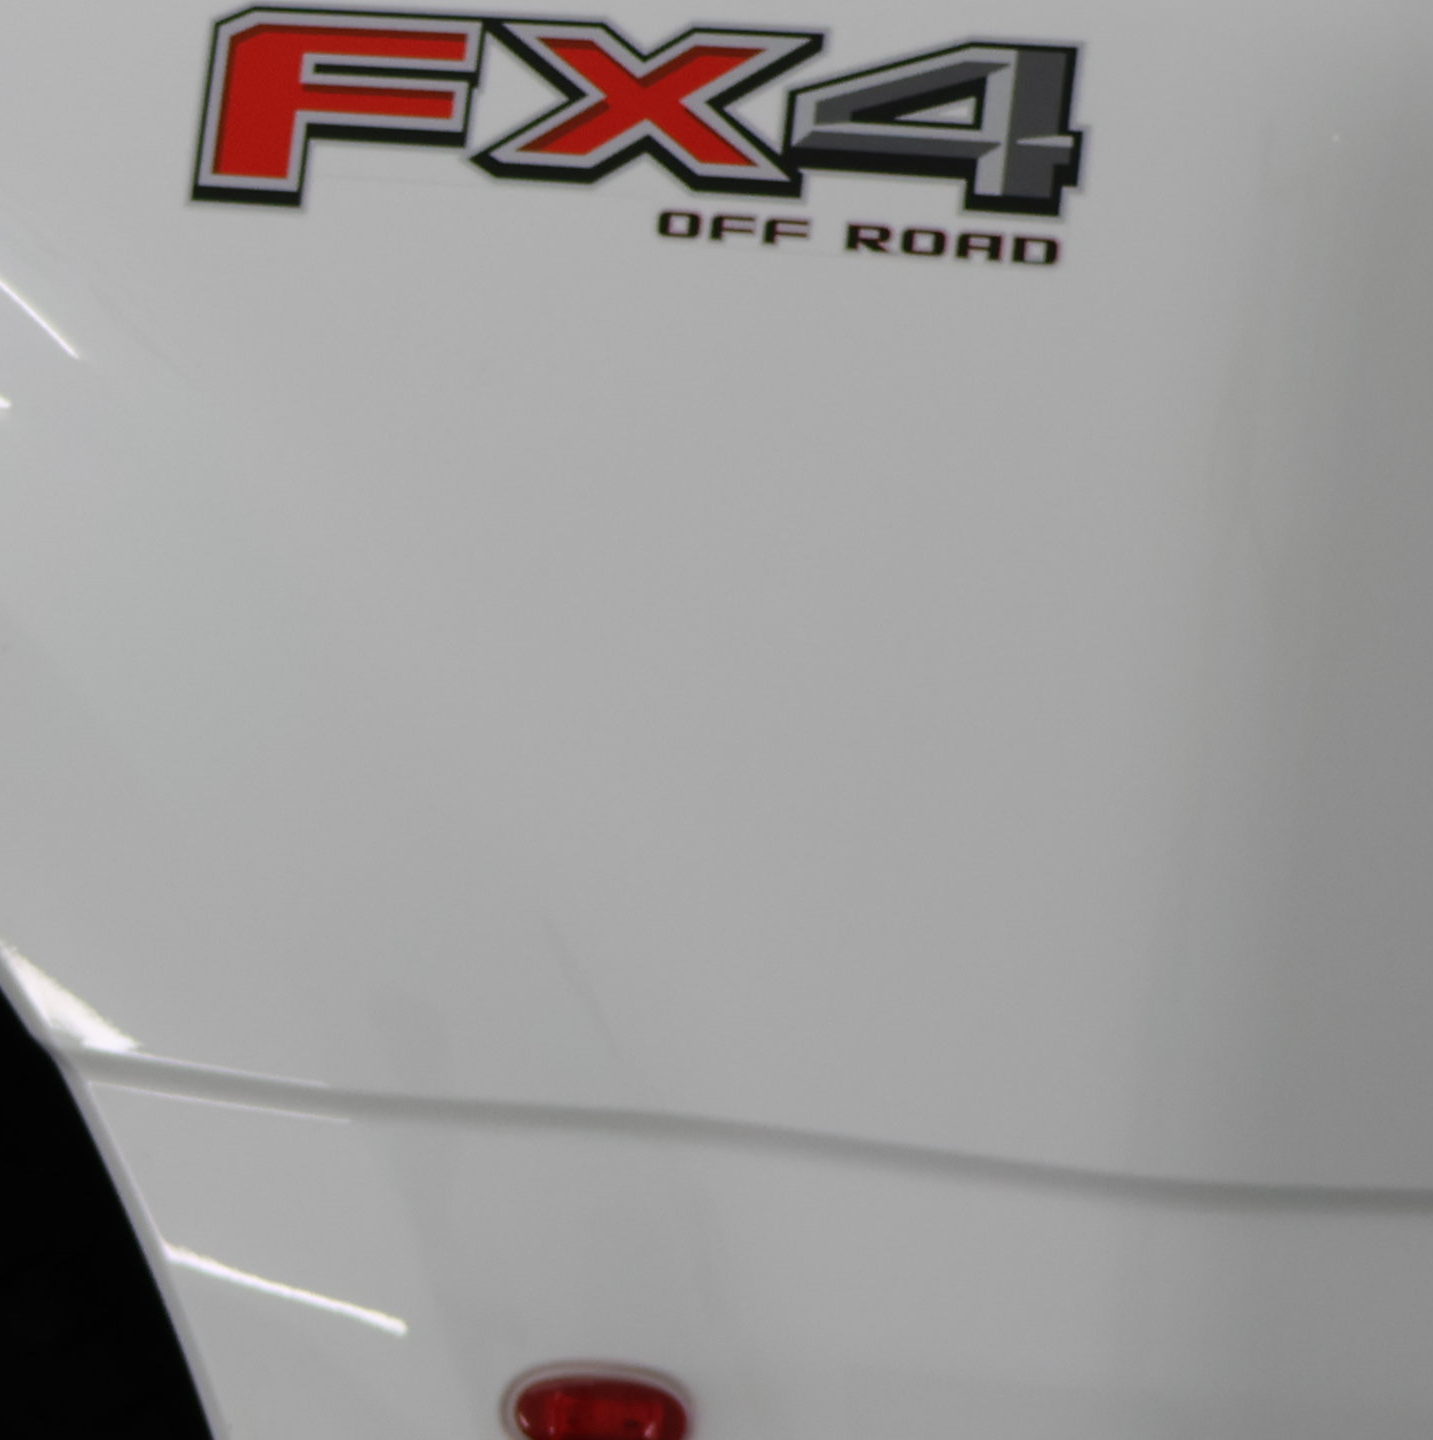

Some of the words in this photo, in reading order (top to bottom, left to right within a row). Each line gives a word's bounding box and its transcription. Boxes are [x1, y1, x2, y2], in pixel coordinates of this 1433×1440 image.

[192, 6, 1083, 216] FX4
[657, 210, 812, 245] OFF
[844, 222, 1060, 265] ROAD
